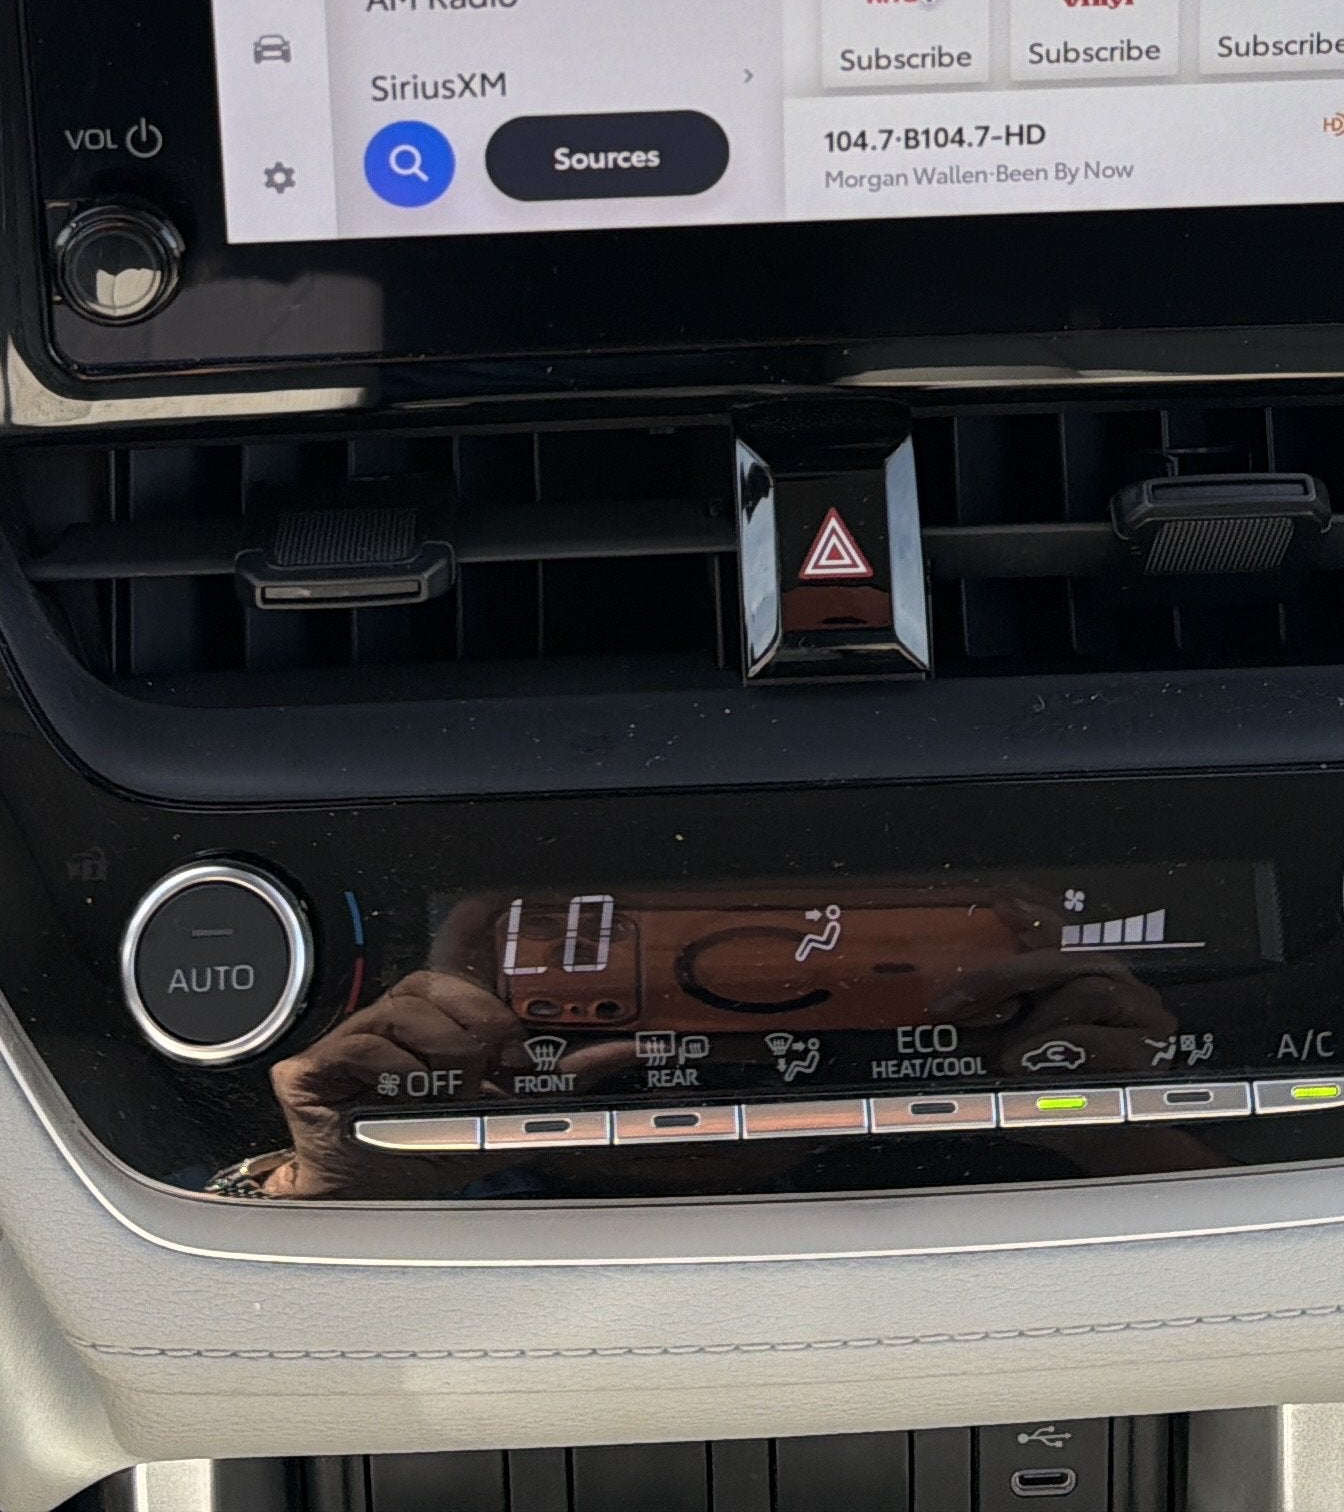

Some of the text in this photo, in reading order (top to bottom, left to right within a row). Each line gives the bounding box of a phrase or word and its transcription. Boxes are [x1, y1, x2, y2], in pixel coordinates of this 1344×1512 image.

[839, 44, 973, 72] Subscribe
[1028, 38, 1162, 65] Subscribe
[370, 71, 508, 103] SiriusXM
[64, 128, 119, 151] VOL
[553, 145, 661, 172] Sources
[824, 168, 910, 194] Morgan
[1054, 161, 1081, 186] By
[1083, 160, 1135, 180] Now
[167, 964, 255, 994] AUTO
[896, 1025, 958, 1053] ECO
[1277, 1029, 1334, 1059] A/C
[647, 1067, 701, 1088] REAR
[871, 1055, 987, 1079] HEAT/COOL
[407, 1070, 463, 1097] OFF
[514, 1073, 577, 1093] FRONT
